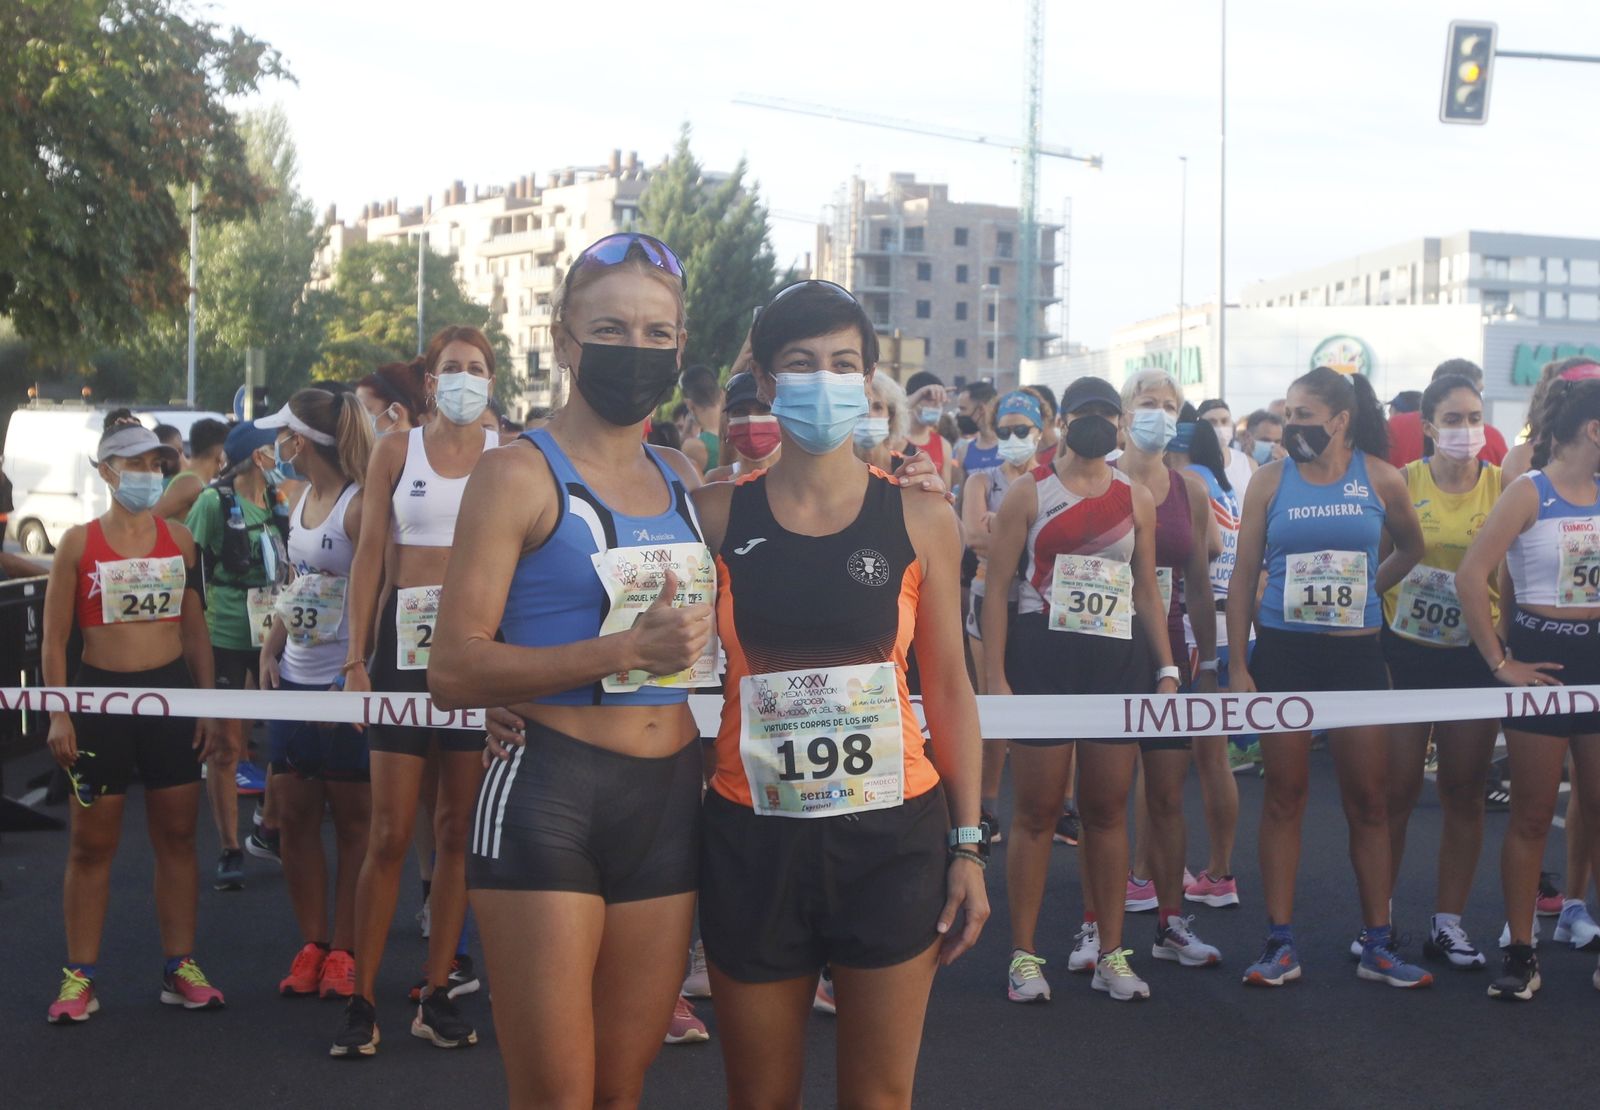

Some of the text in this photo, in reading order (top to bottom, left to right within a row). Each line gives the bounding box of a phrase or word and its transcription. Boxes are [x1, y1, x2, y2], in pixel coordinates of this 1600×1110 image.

[1288, 503, 1363, 521] TROTASIERRA
[122, 591, 171, 616] 242
[1069, 590, 1118, 616] 307
[1303, 585, 1353, 608] 118
[1410, 598, 1461, 629] 508
[1541, 620, 1590, 636] PRO
[787, 674, 829, 690] XXXV
[763, 722, 798, 732] VIRTUDES
[800, 720, 831, 729] CORPAS
[845, 717, 860, 725] LOS
[1123, 695, 1315, 733] IMDECO
[777, 733, 873, 781] 198
[800, 787, 855, 801] serizona
